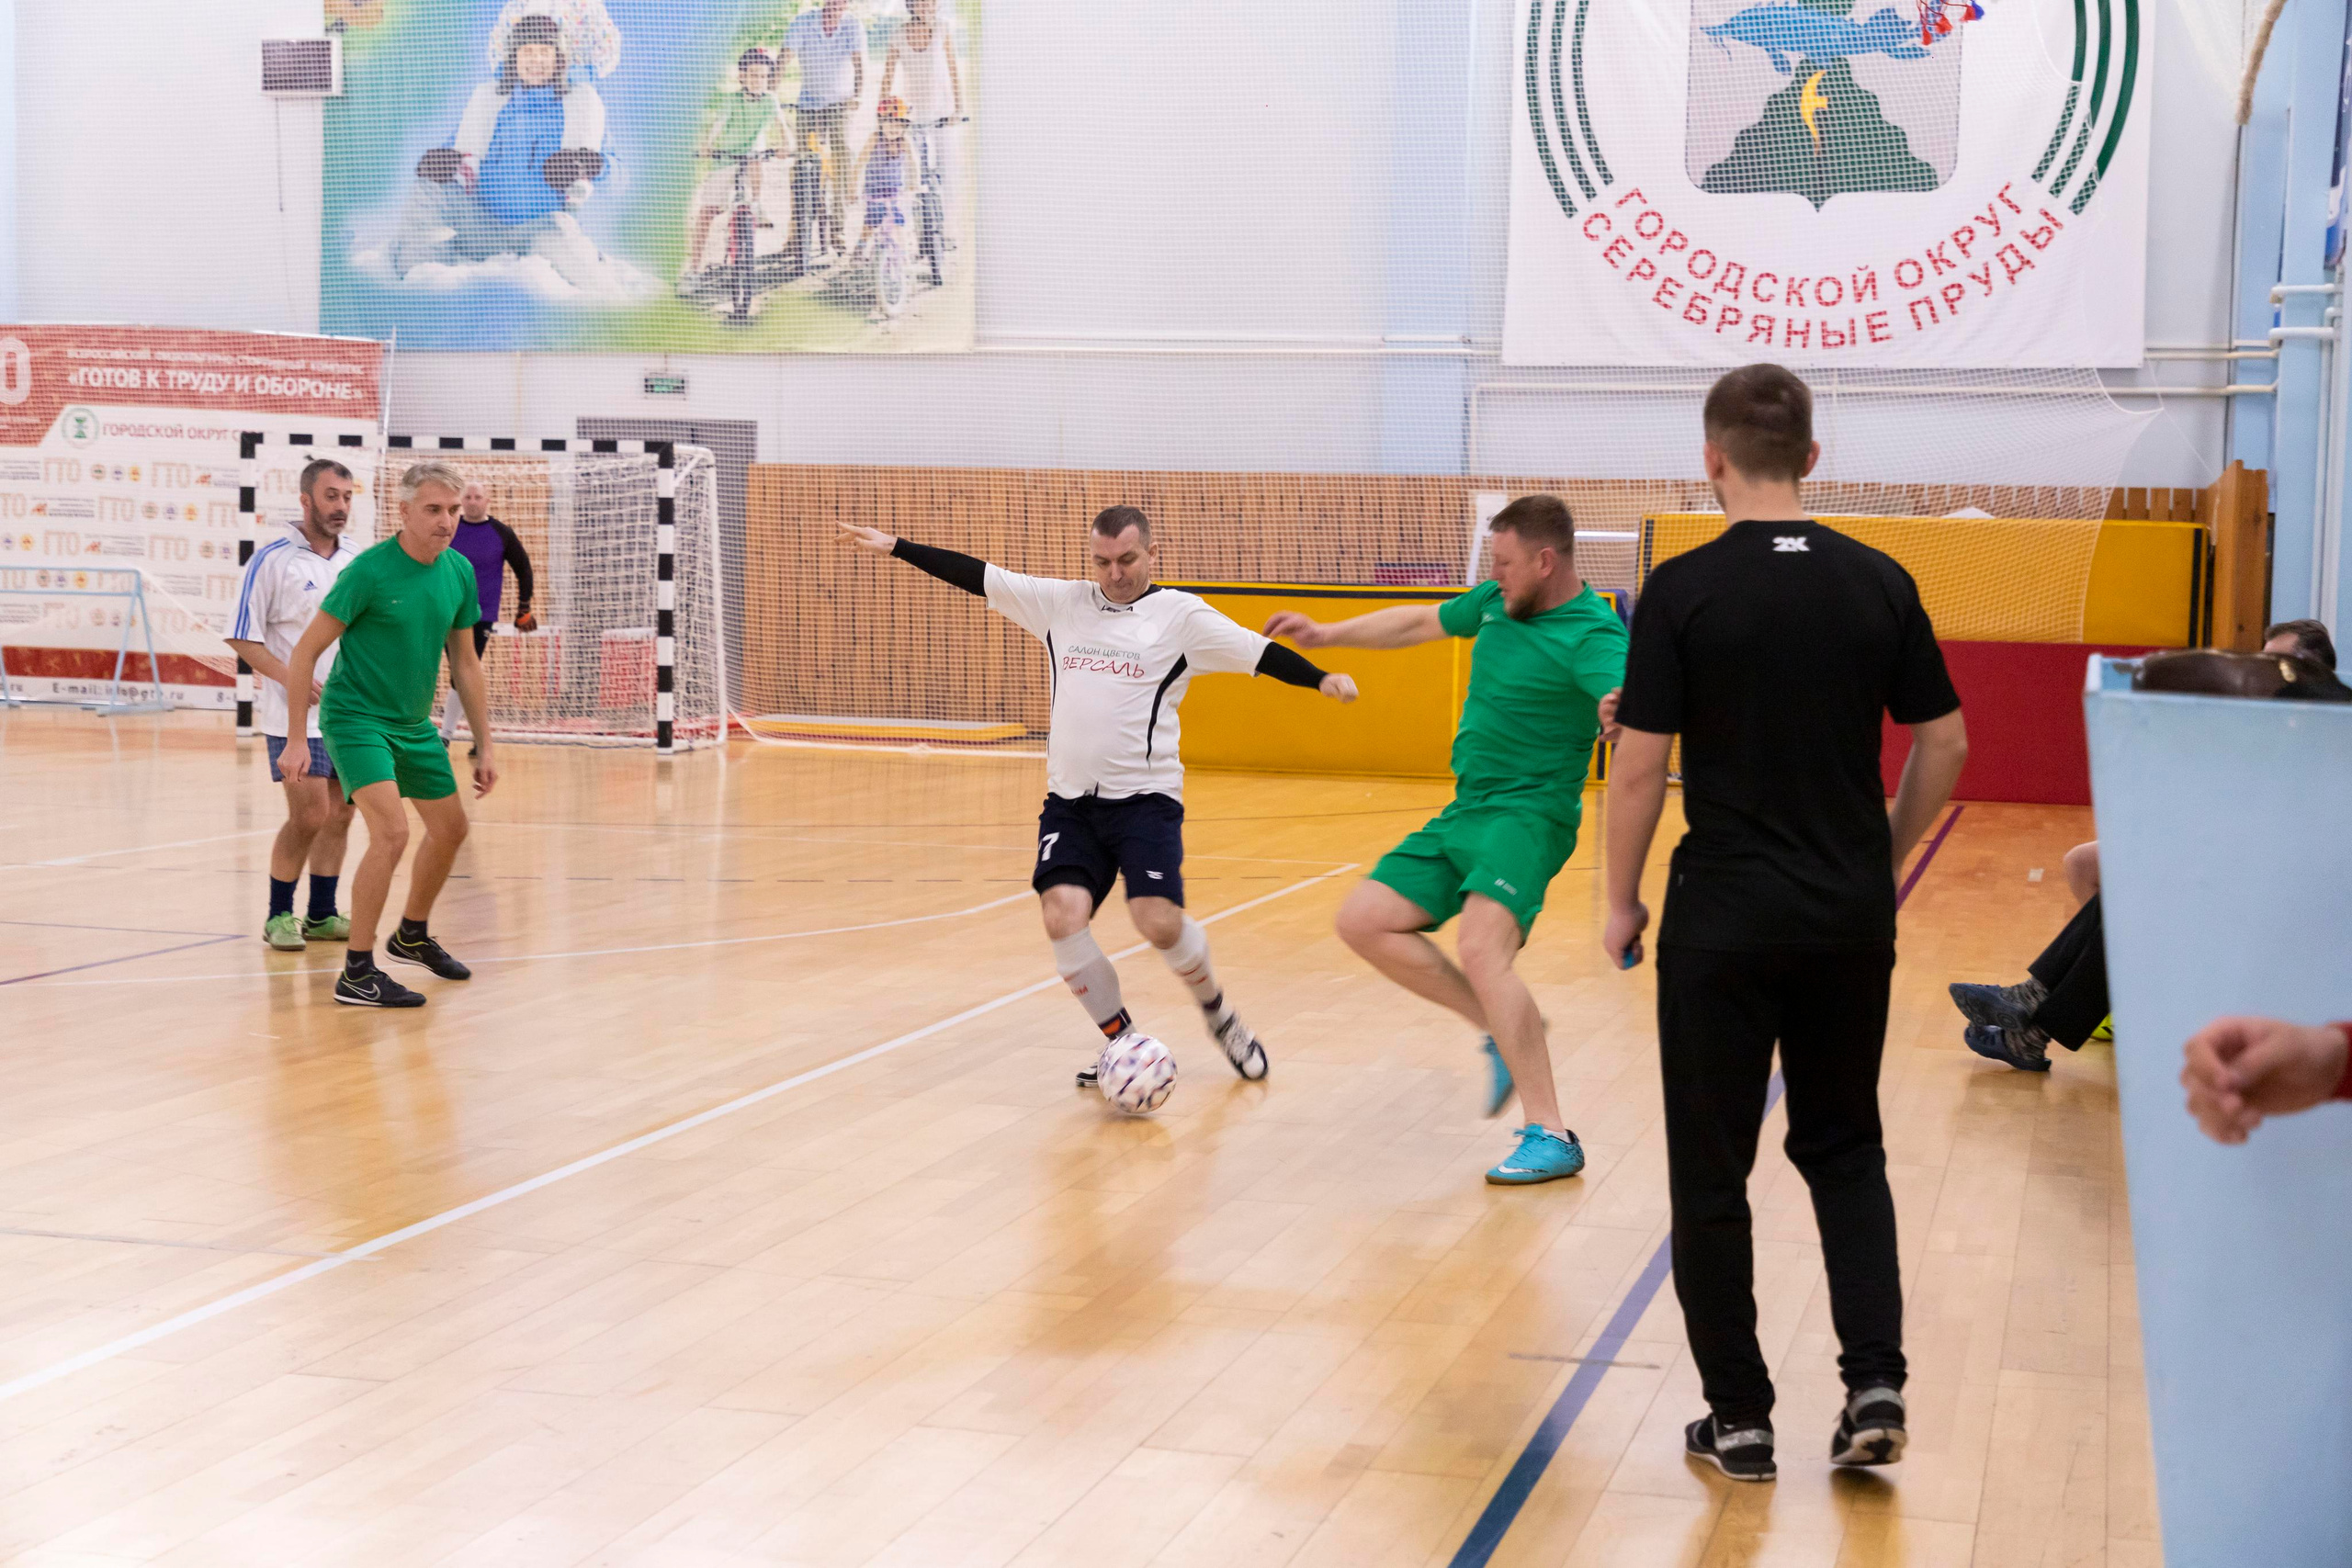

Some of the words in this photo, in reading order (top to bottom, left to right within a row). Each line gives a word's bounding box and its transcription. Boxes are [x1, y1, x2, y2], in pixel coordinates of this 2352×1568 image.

[1615, 187, 1880, 308] ГОРОДСКОЙ
[1894, 182, 2023, 290] ОКРУГ
[1582, 211, 1894, 350] СЕРЕБРЯНЫЕ
[1908, 208, 2065, 331] ПРУДЫ
[146, 369, 162, 389] К
[165, 370, 229, 396] ТРУДУ
[234, 375, 250, 393] И
[102, 423, 184, 439] ГОРОДСКОЙ
[187, 426, 228, 440] ОКРУГ
[1068, 645, 1101, 656] САЛОН
[1102, 649, 1141, 661] ЦВЕТОВ
[1062, 656, 1145, 679] ВЕРСАЛЬ
[1041, 831, 1060, 862] 7
